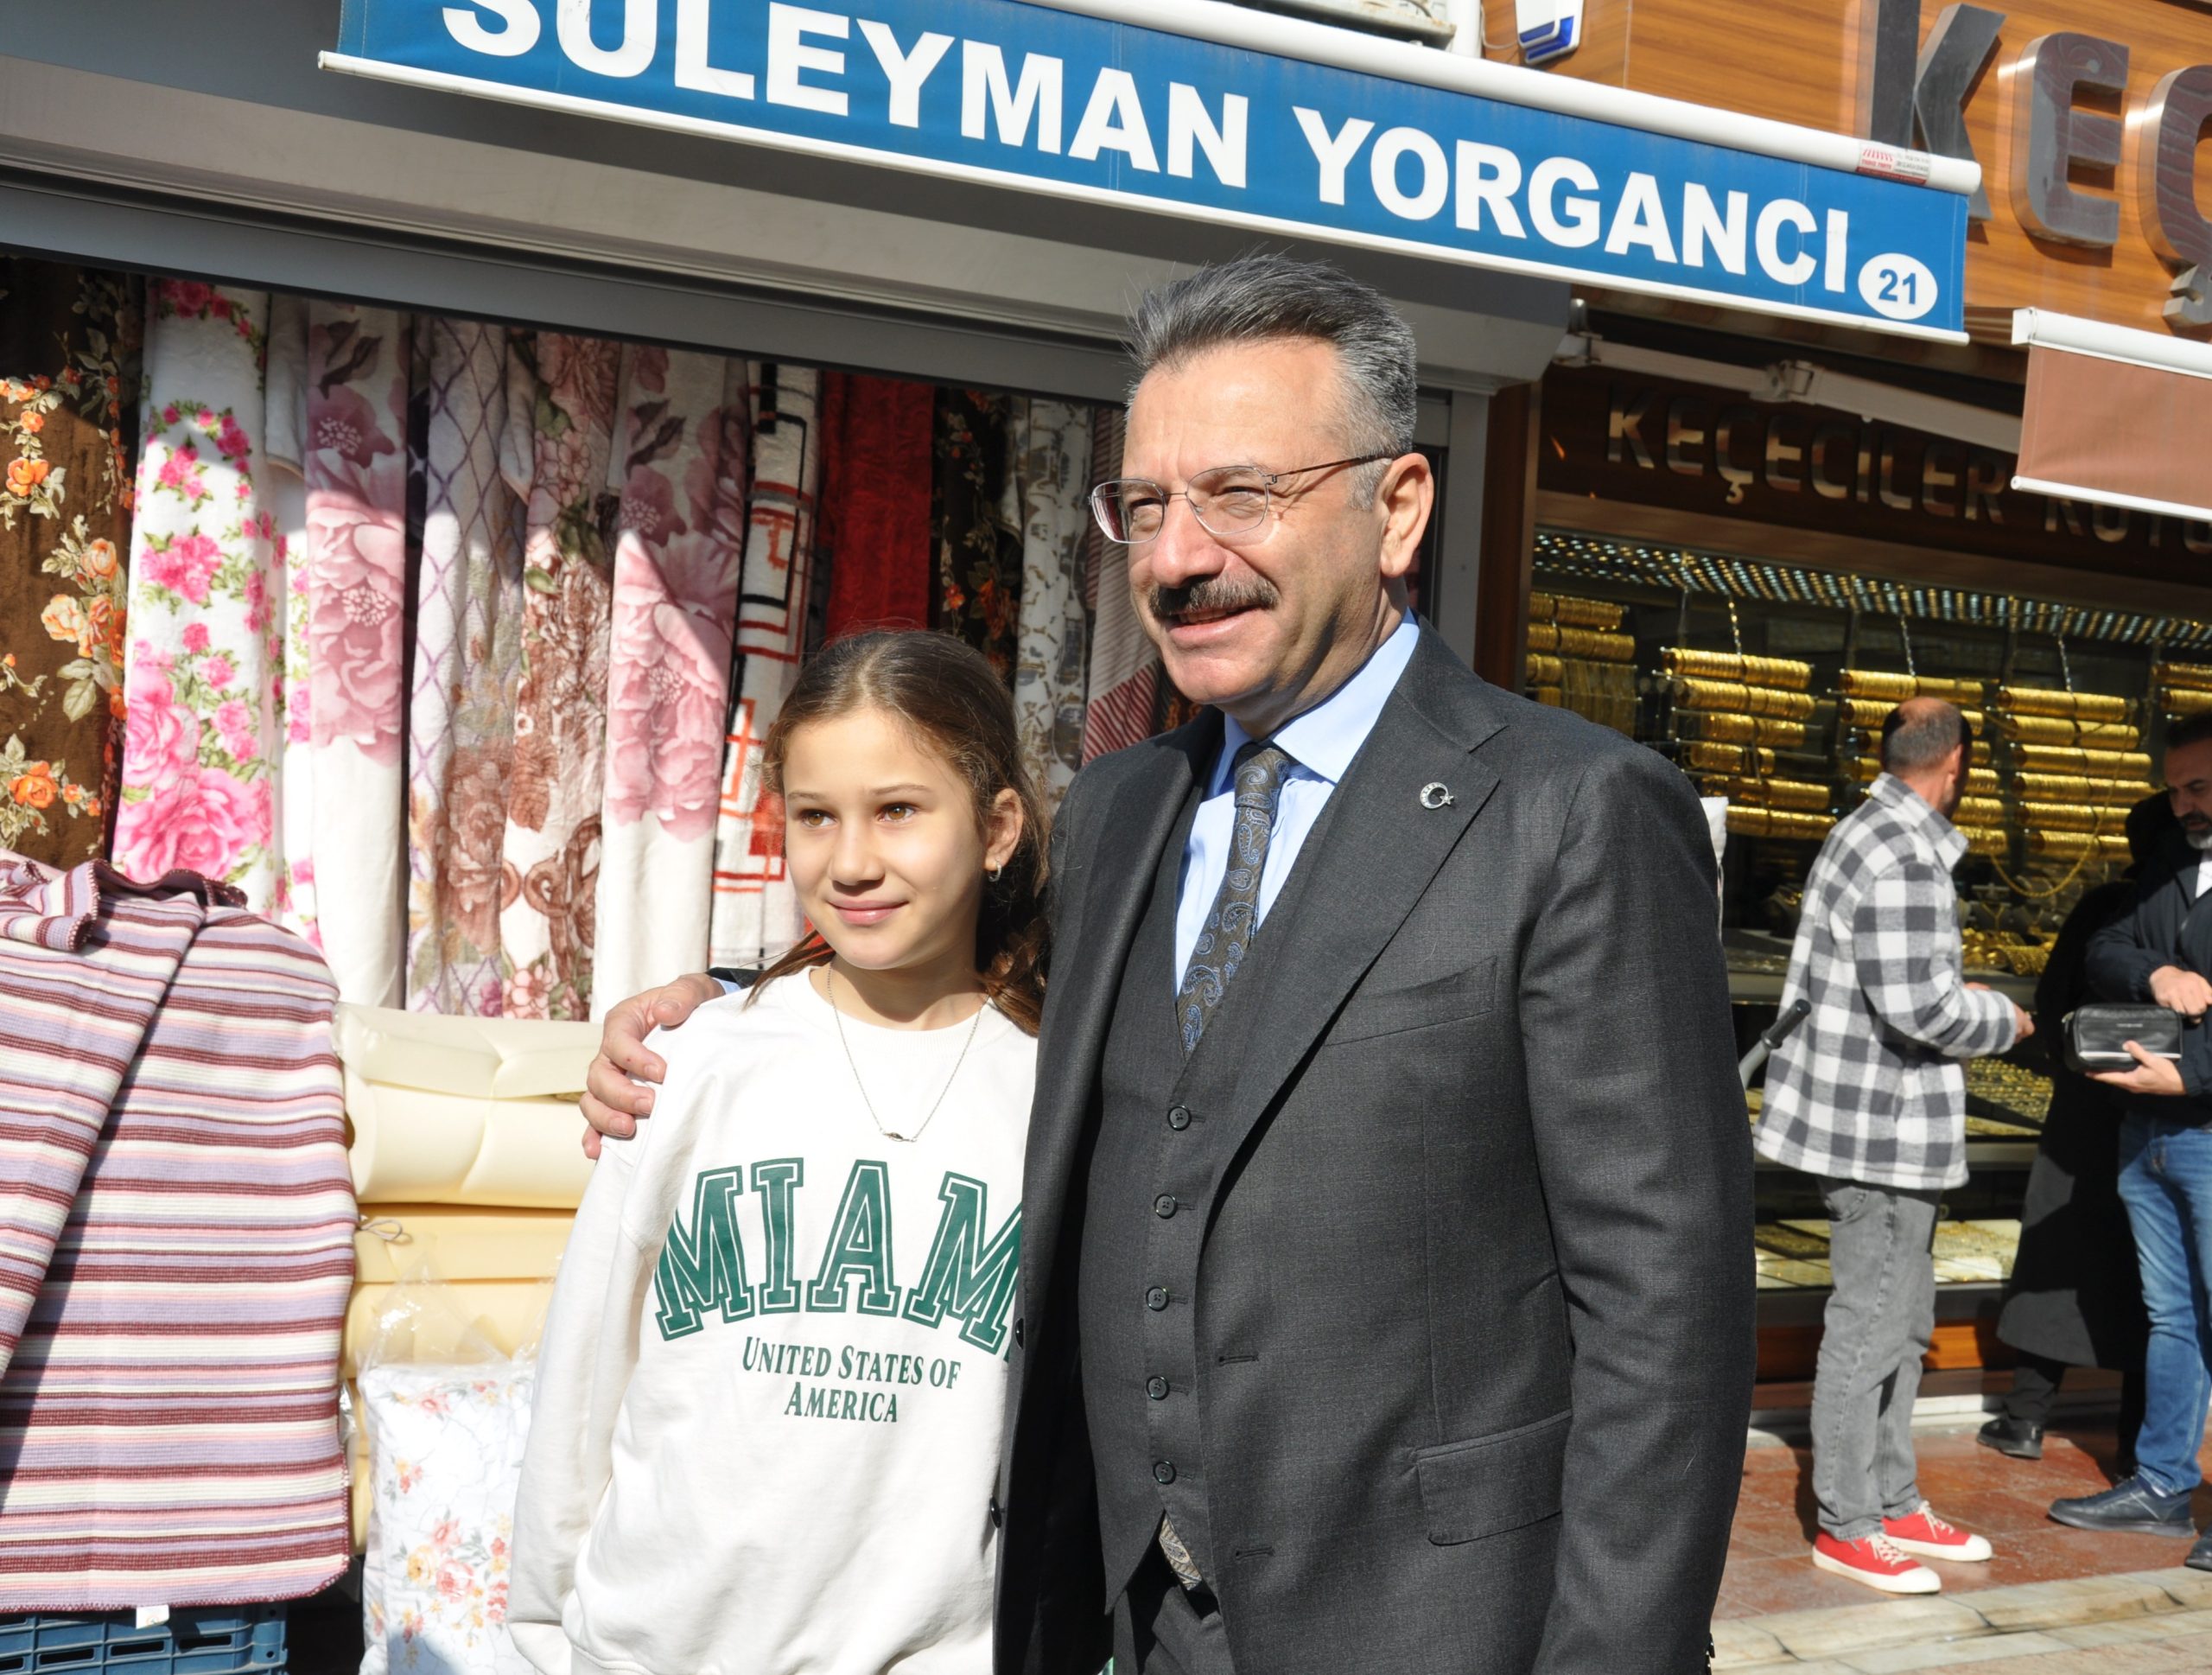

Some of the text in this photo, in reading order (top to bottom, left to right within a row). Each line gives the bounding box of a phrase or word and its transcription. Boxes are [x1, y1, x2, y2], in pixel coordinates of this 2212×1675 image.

[1292, 105, 1849, 294] YORGANCI
[1878, 269, 1916, 304] 21
[654, 1157, 1023, 1363] MIAM
[929, 1357, 962, 1390] OF
